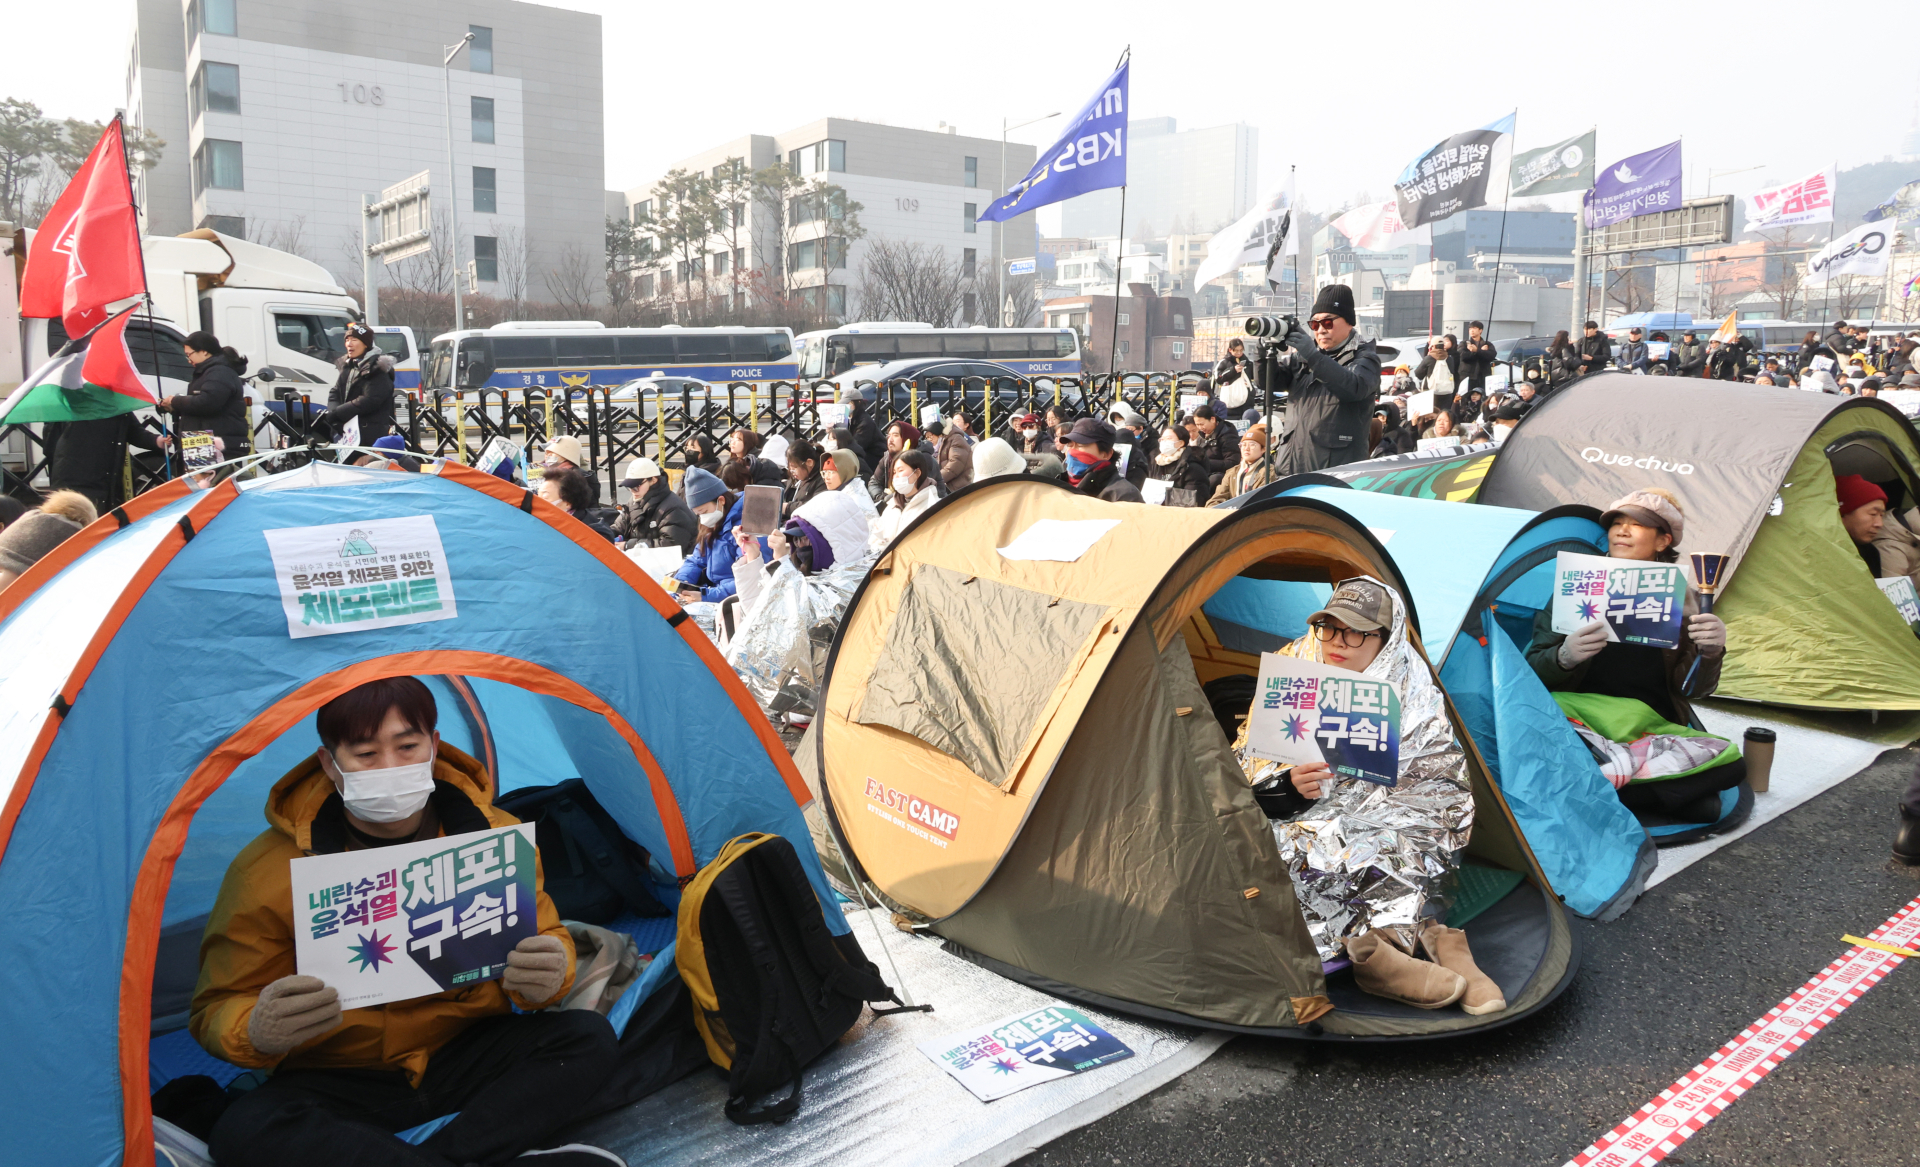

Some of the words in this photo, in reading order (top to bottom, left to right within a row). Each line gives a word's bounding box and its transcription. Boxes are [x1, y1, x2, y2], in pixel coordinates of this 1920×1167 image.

[336, 82, 385, 106] 108
[894, 197, 919, 212] 109
[523, 374, 545, 385] 경찰
[731, 368, 763, 378] POLICE
[1028, 363, 1053, 371] POLICE
[190, 437, 208, 446] 윤석열
[1580, 447, 1695, 475] Quechua
[292, 570, 345, 591] 윤석열
[347, 564, 398, 584] 체포를
[401, 559, 435, 577] 위한
[354, 556, 378, 565] 시민이
[400, 550, 431, 560] 체포한다
[1562, 570, 1607, 581] 내란수괴
[1608, 568, 1677, 596] 체포!
[298, 577, 443, 626] 체포텐트
[1561, 581, 1605, 596] 윤석열
[1607, 596, 1673, 624] 구속!
[1266, 677, 1319, 691] 내란수괴
[1320, 679, 1390, 717] 체포!
[1263, 692, 1317, 710] 윤석열
[1317, 716, 1389, 752] 구속!
[867, 803, 892, 822] STYLISH
[893, 816, 906, 829] ONE
[906, 823, 929, 841] TOUCH
[929, 834, 948, 849] TENT
[309, 868, 397, 910] 내란수괴
[405, 832, 517, 910] 체포!
[310, 890, 398, 940] 윤석열
[410, 882, 519, 961] 구속!
[941, 1034, 994, 1061] 내란수괴
[999, 1007, 1072, 1049] 체포!
[951, 1042, 1007, 1070] 윤석열
[1017, 1023, 1098, 1063] 구속!
[1622, 1131, 1655, 1152] 위험
[1673, 1077, 1727, 1111] 안전제일
[1722, 1046, 1764, 1073] DANGER
[1757, 1030, 1786, 1045] 위험
[1795, 987, 1840, 1014] 안전제일
[1834, 964, 1869, 984] DANGER
[1861, 951, 1886, 963] 위험
